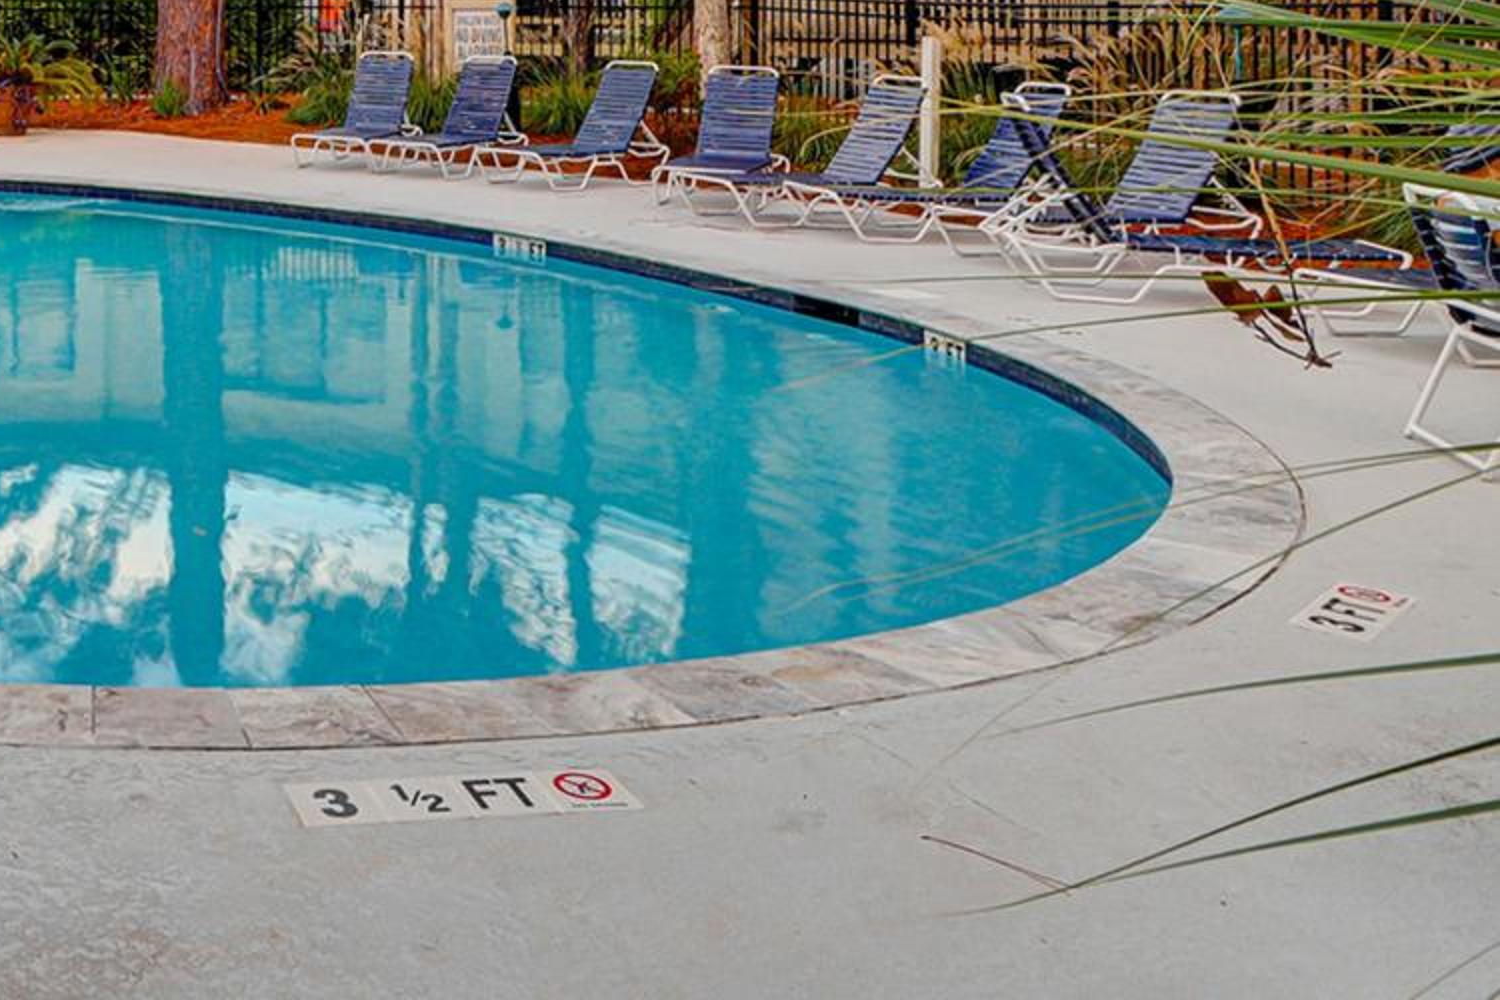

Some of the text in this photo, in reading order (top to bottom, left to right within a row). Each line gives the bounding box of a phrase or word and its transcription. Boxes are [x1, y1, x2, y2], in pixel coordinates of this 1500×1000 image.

[1321, 597, 1386, 622] FT
[1308, 615, 1365, 633] 3
[313, 788, 359, 819] 3
[461, 777, 536, 810] FT
